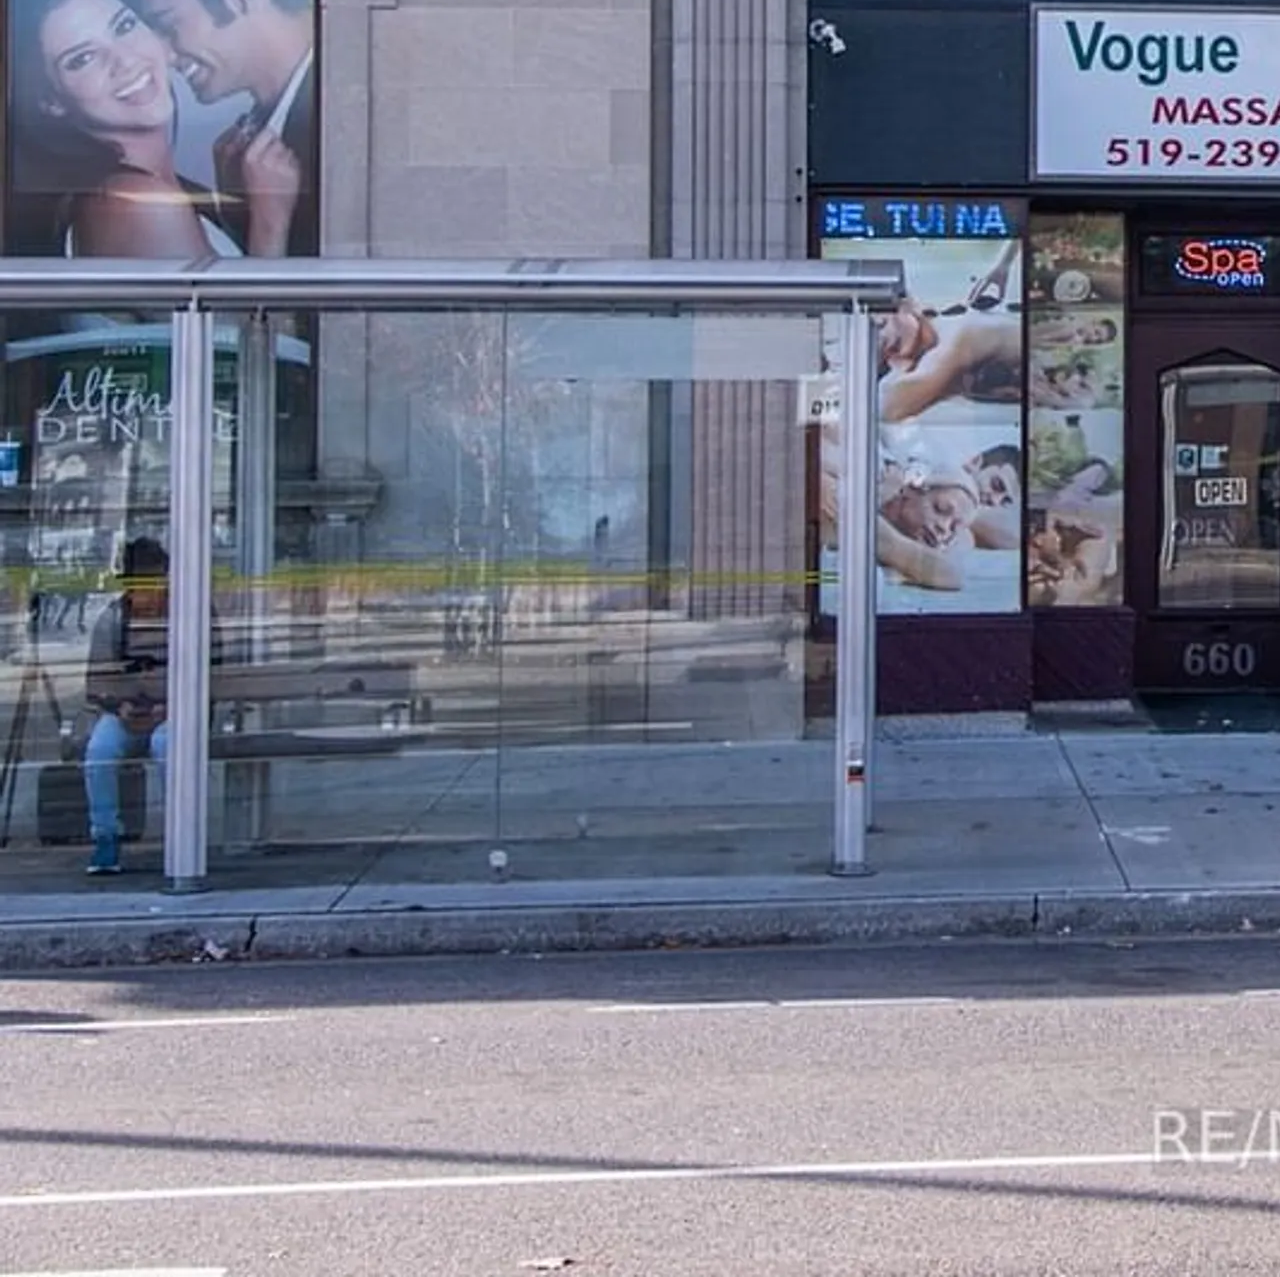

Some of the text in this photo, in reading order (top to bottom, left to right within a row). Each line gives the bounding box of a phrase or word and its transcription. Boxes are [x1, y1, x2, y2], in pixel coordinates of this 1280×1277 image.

[1065, 20, 1239, 86] Vogue
[886, 204, 944, 234] TUI
[956, 204, 1006, 234] NA
[1184, 242, 1259, 279] Spa
[1200, 481, 1244, 502] OPEN
[1184, 643, 1254, 676] 660
